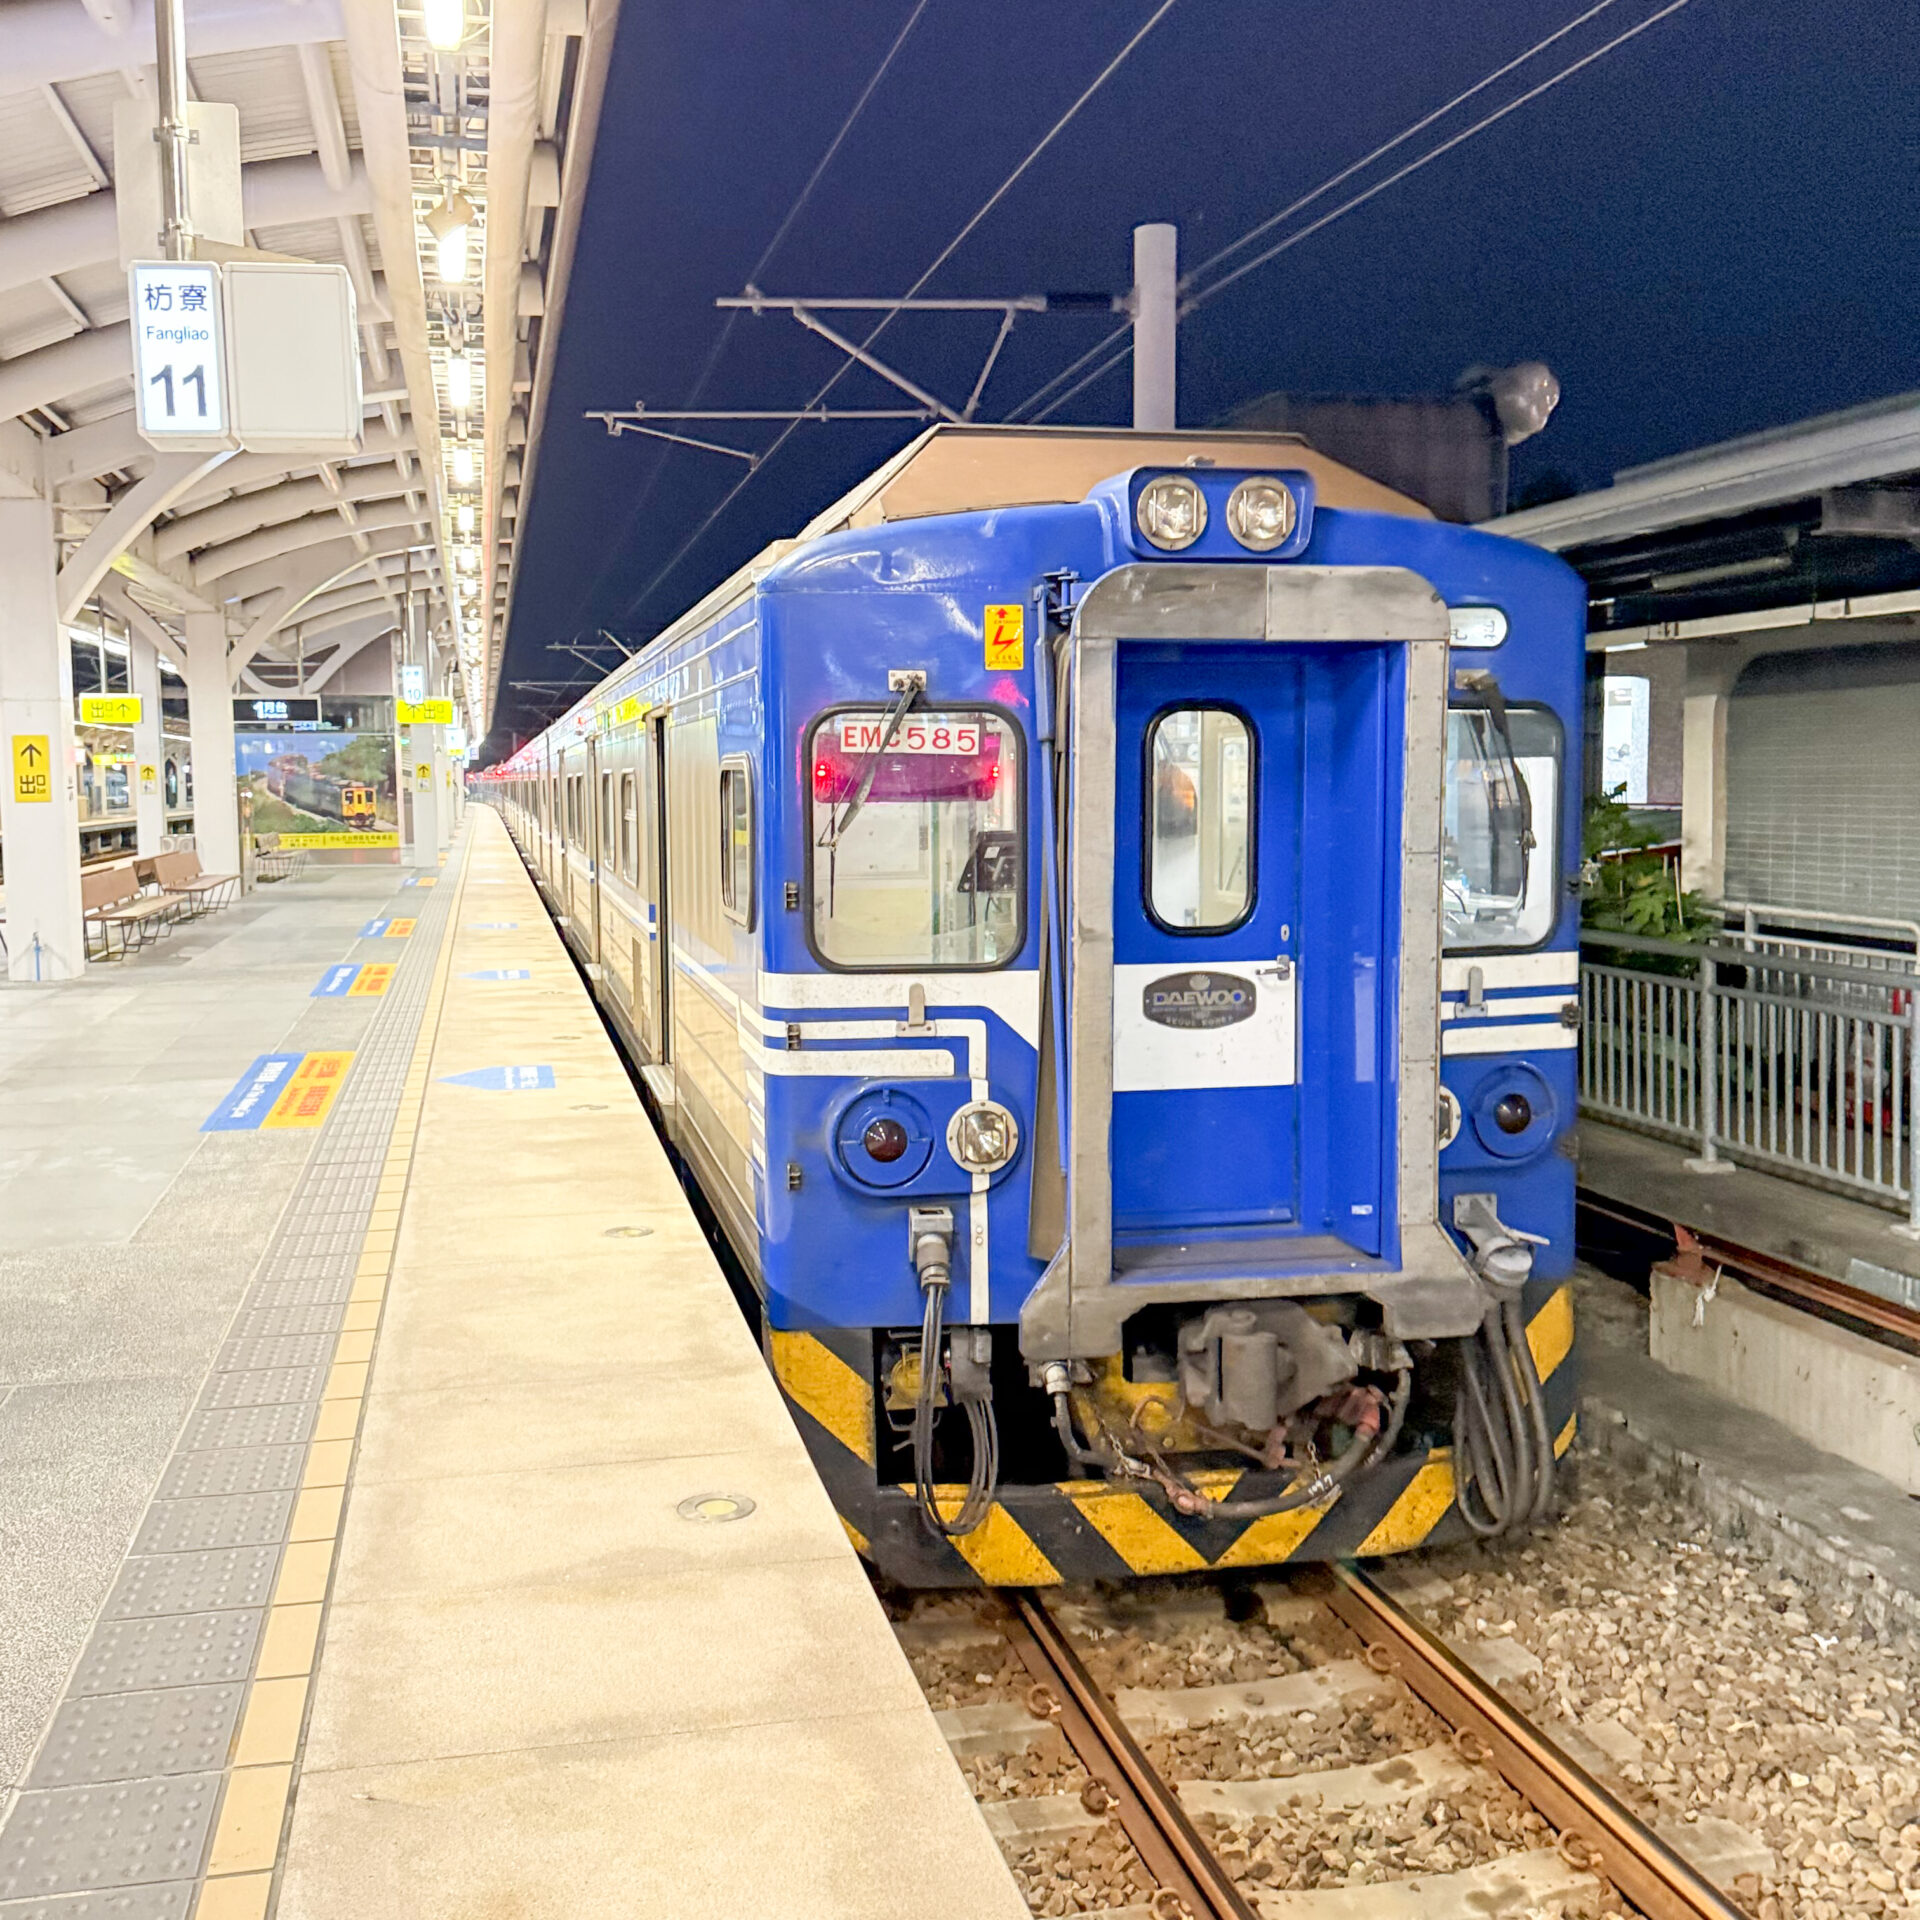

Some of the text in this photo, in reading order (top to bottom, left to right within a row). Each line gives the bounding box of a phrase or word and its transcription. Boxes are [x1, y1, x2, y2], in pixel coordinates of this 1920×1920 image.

[144, 283, 208, 312] 枋寮
[146, 325, 209, 344] Fangliao
[150, 364, 207, 417] 11
[408, 688, 422, 701] 10
[91, 702, 114, 718] 出口
[424, 703, 445, 720] 出口
[20, 774, 46, 795] 出口
[1152, 989, 1246, 1007] DAEWOO
